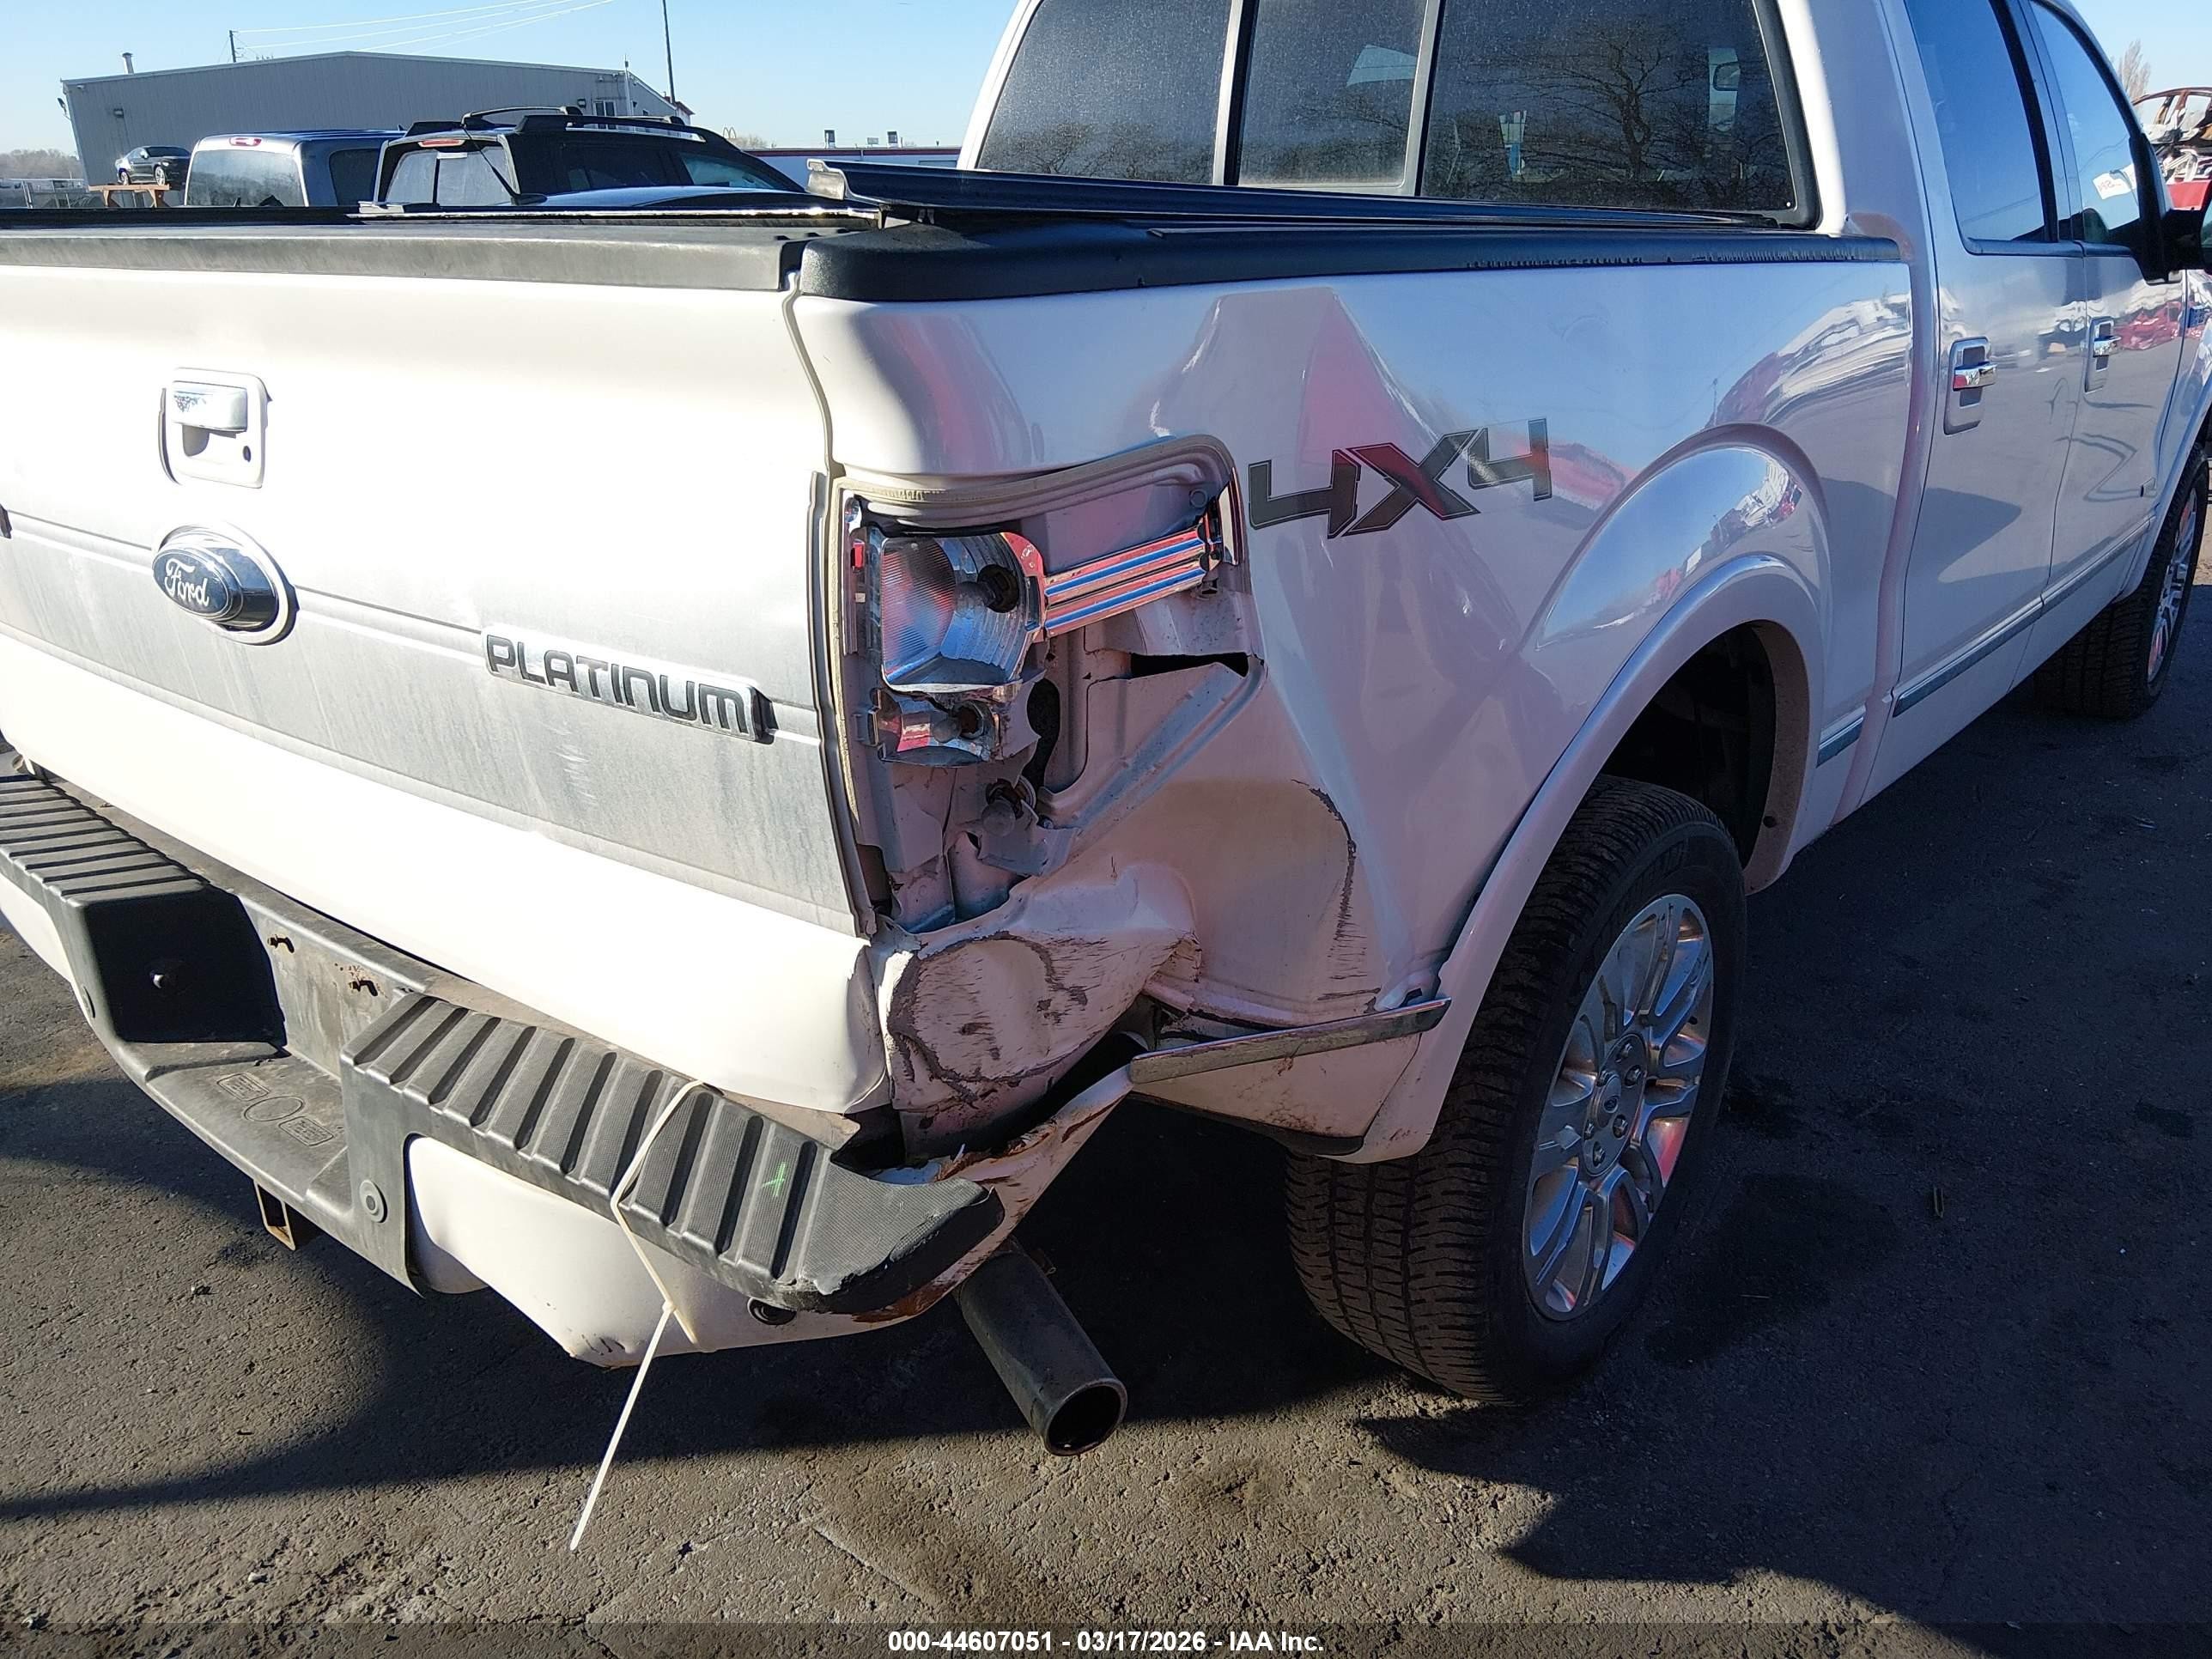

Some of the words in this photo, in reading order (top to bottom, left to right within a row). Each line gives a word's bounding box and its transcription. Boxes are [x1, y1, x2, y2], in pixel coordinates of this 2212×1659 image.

[1248, 417, 1553, 539] 4X4
[164, 557, 210, 607] Ford
[486, 634, 750, 735] PLATINUM
